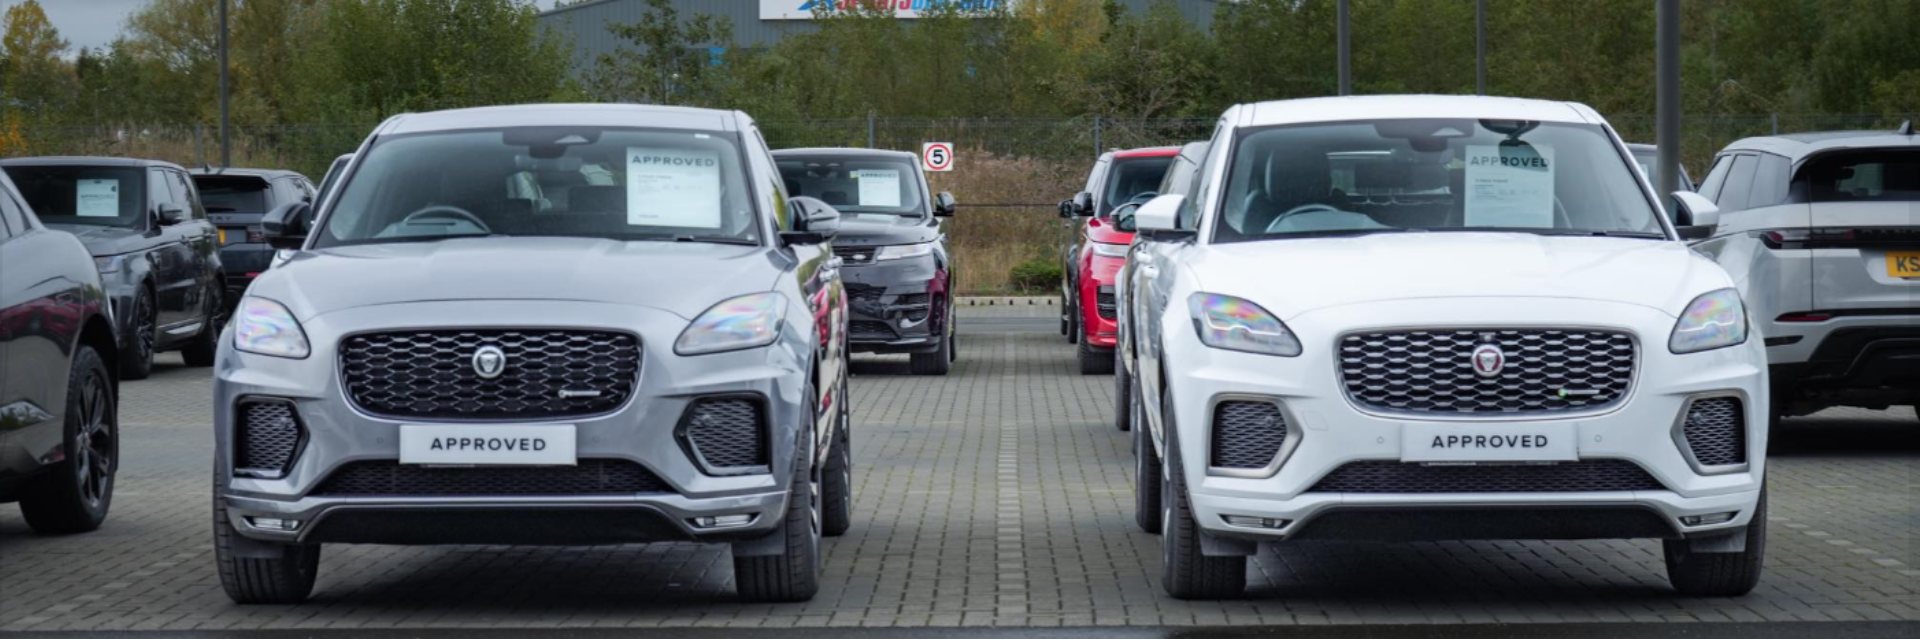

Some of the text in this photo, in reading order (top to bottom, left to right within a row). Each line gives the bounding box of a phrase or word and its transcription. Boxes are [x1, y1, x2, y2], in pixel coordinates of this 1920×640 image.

[632, 155, 715, 168] APPROVED
[933, 149, 944, 165] 5
[1470, 155, 1550, 168] APPROVED
[430, 437, 547, 452] APPROVED
[1431, 434, 1549, 449] APPROVED
